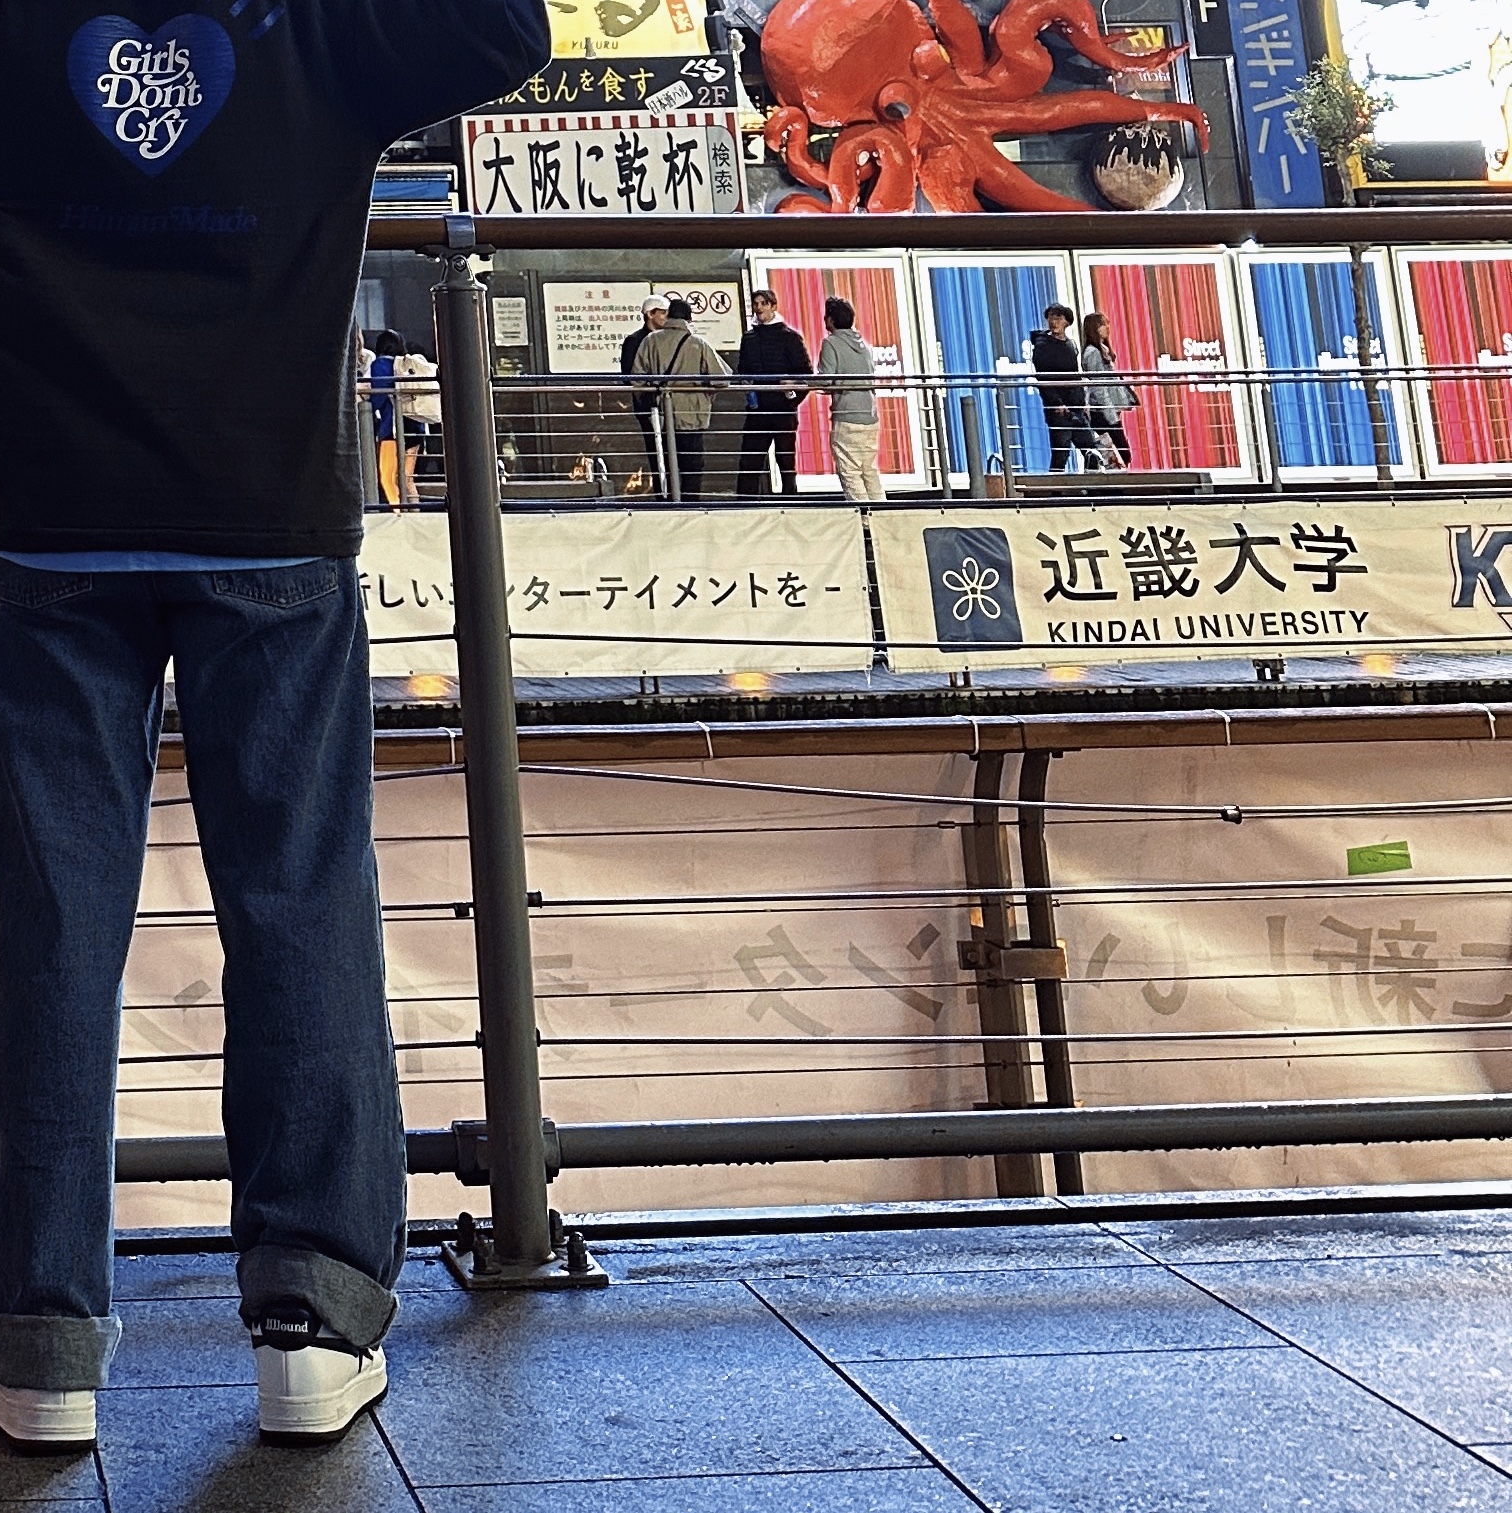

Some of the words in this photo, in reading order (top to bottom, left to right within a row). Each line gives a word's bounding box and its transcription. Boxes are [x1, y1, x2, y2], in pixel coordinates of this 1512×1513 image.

[108, 38, 190, 86] Girls
[696, 85, 730, 107] 2F
[115, 105, 189, 160] Cry
[482, 130, 704, 215] 大阪に乾杯
[711, 141, 734, 195] 検索
[1034, 521, 1368, 604] 近畿大学
[1046, 617, 1161, 644] KINDAI
[1175, 609, 1371, 641] UNIVERSITY
